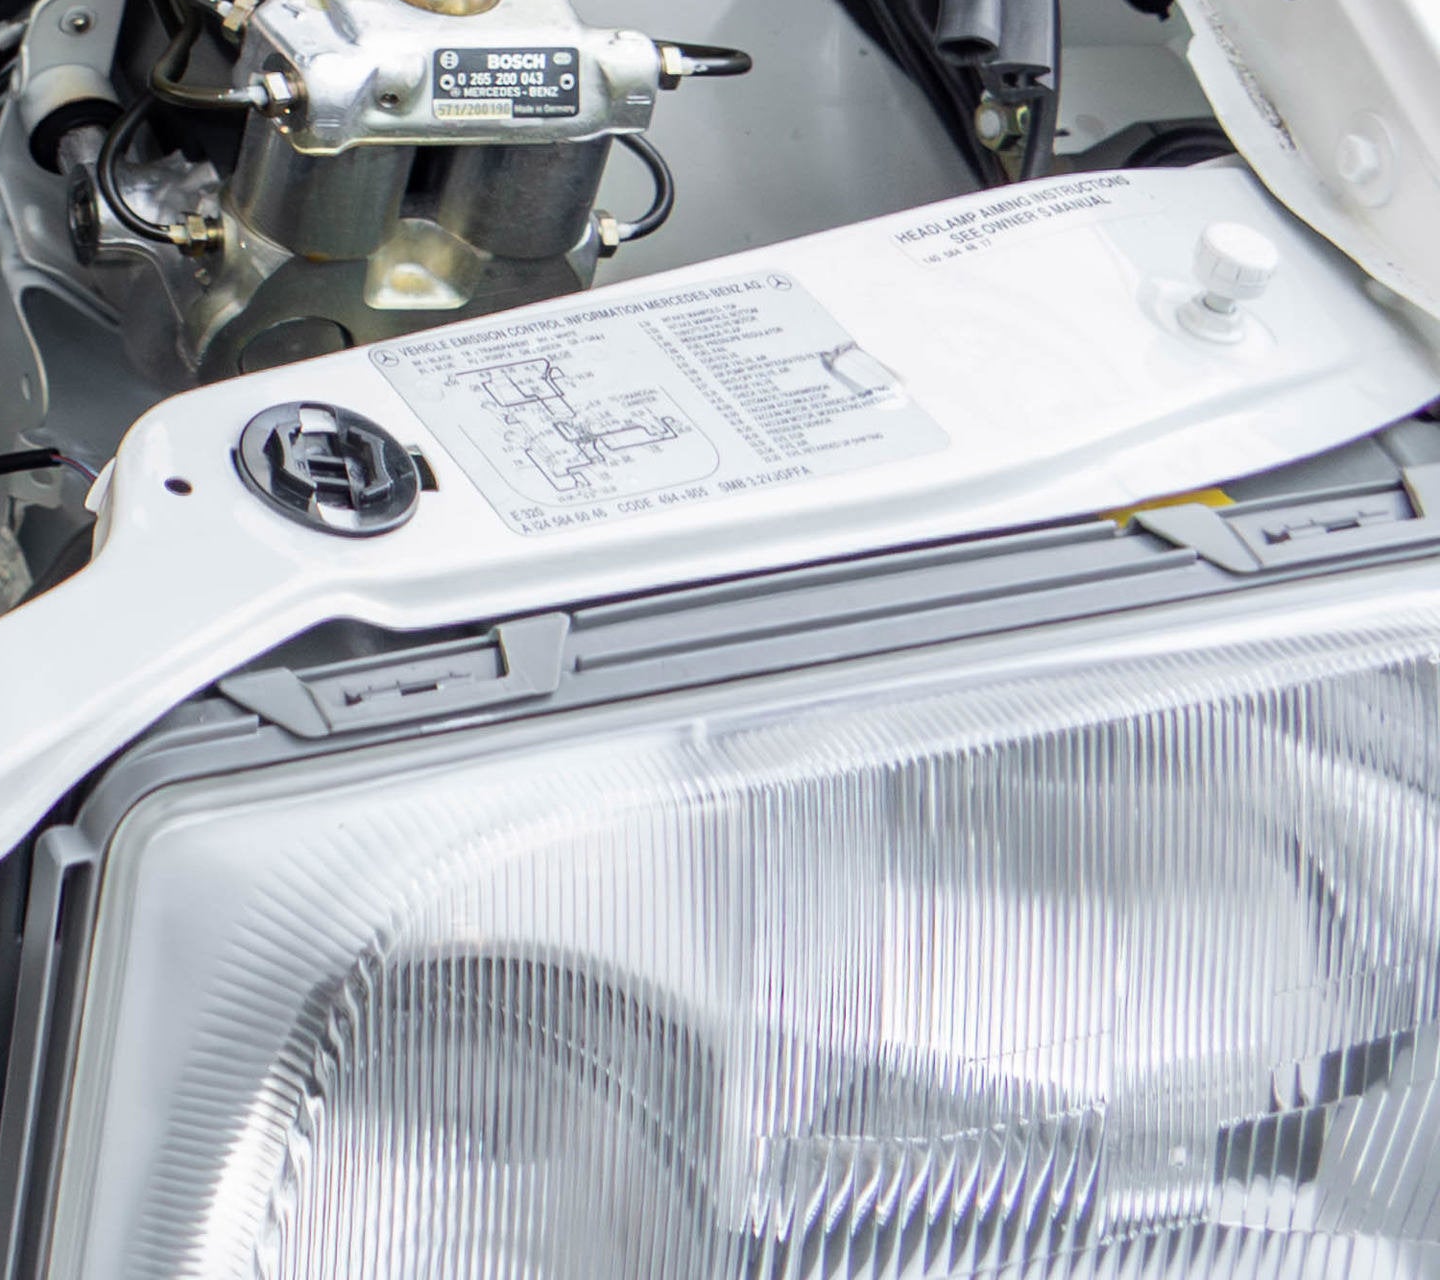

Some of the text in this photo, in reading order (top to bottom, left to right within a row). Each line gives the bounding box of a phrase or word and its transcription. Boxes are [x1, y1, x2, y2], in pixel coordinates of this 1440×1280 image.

[457, 72, 467, 86] 0
[495, 72, 518, 86] 200
[487, 53, 546, 70] BOSCH
[895, 175, 1130, 244] HEADLAMP AIMING INSTRUCTIONS
[950, 226, 982, 245] SEE
[1049, 194, 1112, 217] MANUAL
[399, 340, 449, 358] VEHICLE
[509, 318, 565, 338] CONTROL
[565, 303, 644, 326] INFORMATION
